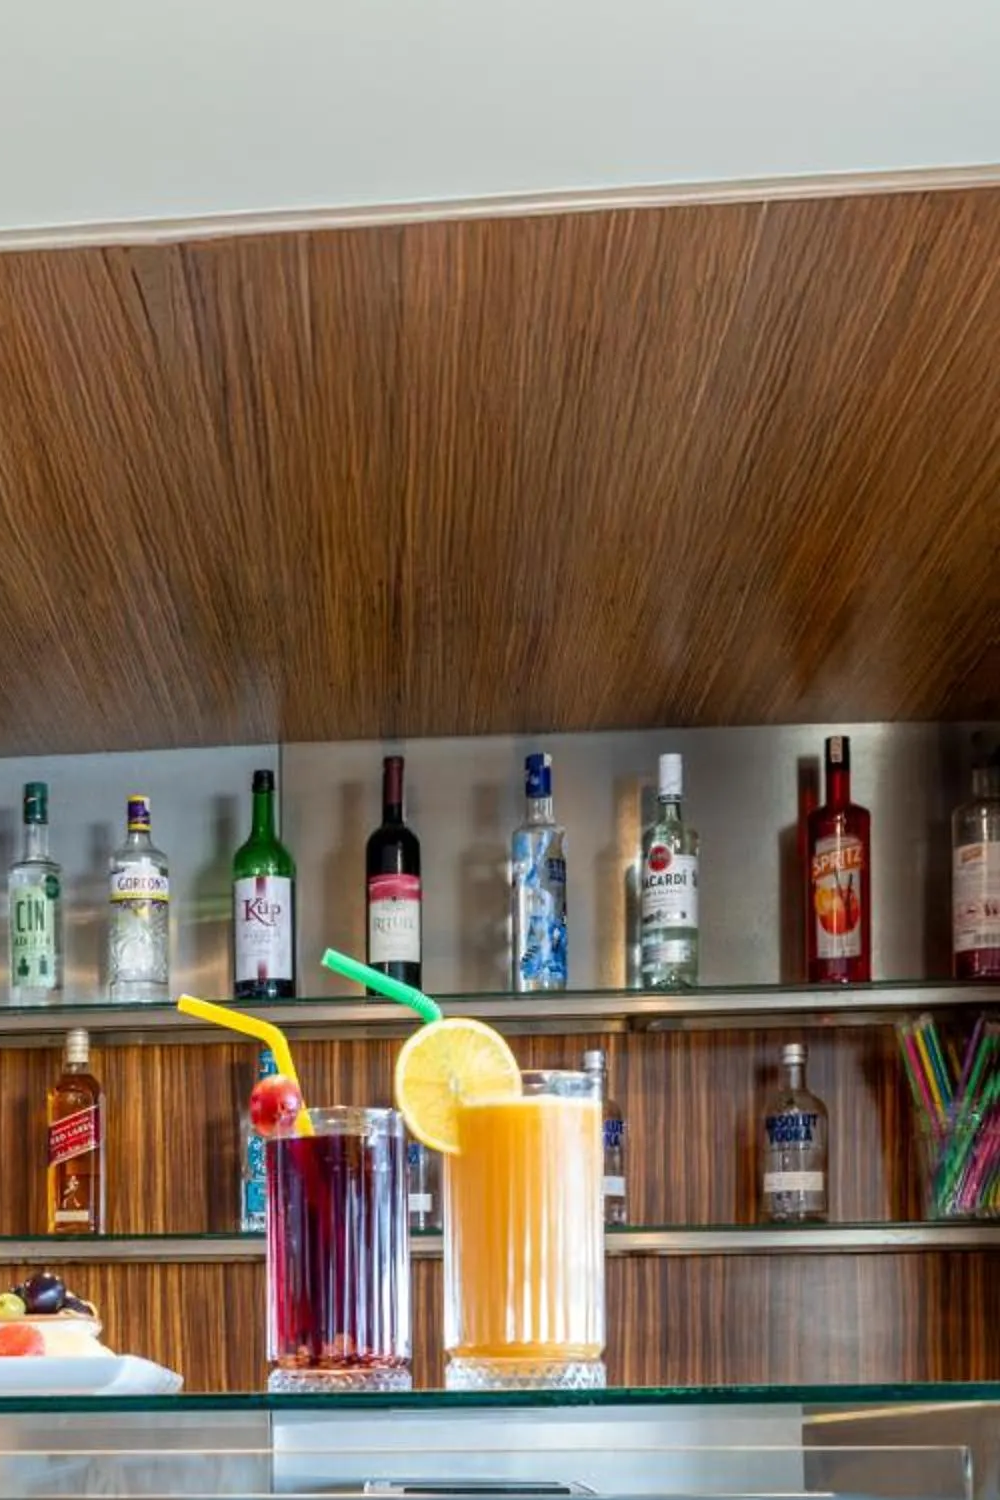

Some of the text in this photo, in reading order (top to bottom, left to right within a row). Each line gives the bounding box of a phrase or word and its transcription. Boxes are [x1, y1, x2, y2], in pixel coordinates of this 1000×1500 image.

[812, 846, 861, 877] SPRITZ
[642, 868, 686, 889] ACARDÍ
[243, 897, 282, 927] Küp
[765, 1112, 818, 1130] ABSOLUT
